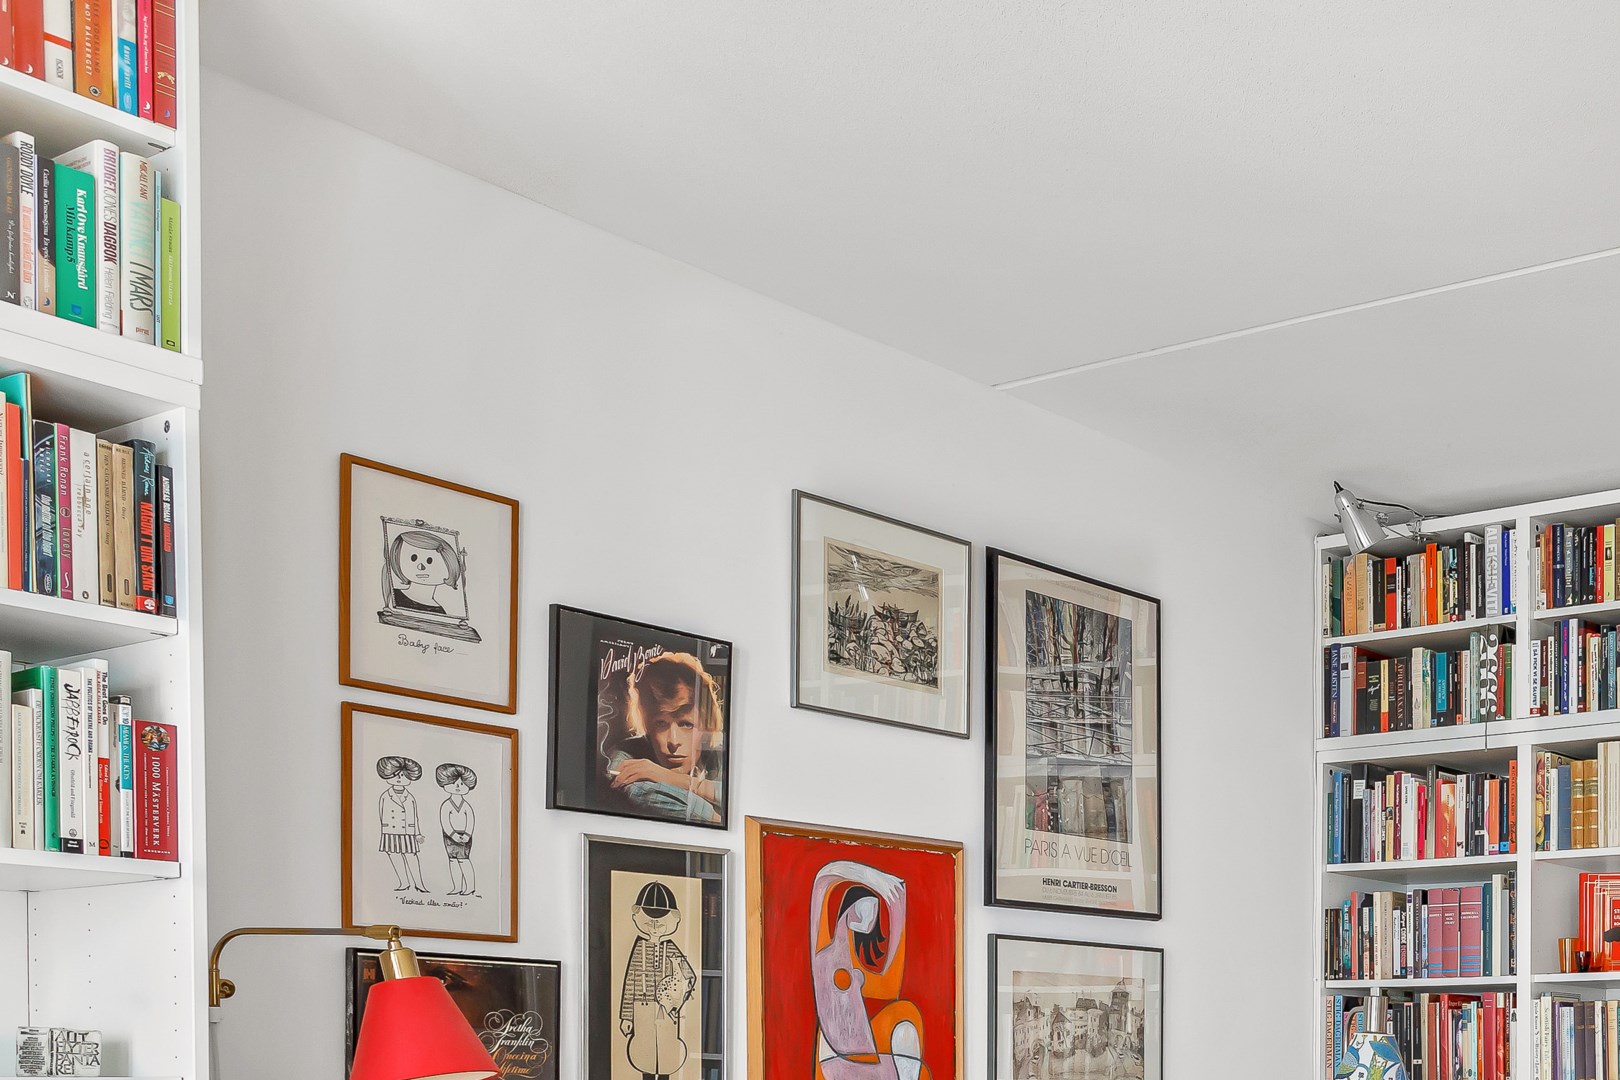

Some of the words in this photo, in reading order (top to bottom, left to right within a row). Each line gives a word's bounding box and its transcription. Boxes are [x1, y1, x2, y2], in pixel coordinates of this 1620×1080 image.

[20, 141, 34, 169] RODDY
[20, 169, 34, 197] DOYLE
[103, 148, 117, 194] BRIDGET
[76, 189, 88, 213] Karl
[65, 205, 76, 227] Min
[76, 212, 87, 234] Ove
[103, 221, 117, 266] DAGBOK
[75, 234, 89, 290] Knausgård
[103, 266, 116, 289] Helen
[102, 289, 116, 320] Fielding
[129, 270, 154, 316] MARS
[59, 434, 69, 462] Frank
[59, 466, 69, 496] Ronan
[162, 476, 171, 503] ANDREAS
[139, 502, 155, 537] NÅGON
[162, 503, 171, 523] ROMAN
[60, 526, 72, 559] lovely
[140, 545, 155, 565] DIN
[141, 564, 156, 592] SÄNG
[397, 633, 430, 654] Baby
[433, 642, 455, 654] face
[1532, 648, 1539, 658] SÅ
[600, 645, 633, 681] David
[633, 643, 664, 683] Bowie
[1331, 649, 1339, 669] JANE
[1331, 669, 1339, 699] AUSTEN
[1480, 633, 1499, 716] 2666
[101, 716, 108, 727] On
[151, 756, 161, 779] 1000
[151, 781, 161, 846] MÄSTERVERK
[1024, 837, 1058, 859] PARIS
[1060, 843, 1072, 860] A
[1074, 845, 1098, 864] VUE
[1042, 877, 1062, 887] HENRI
[1062, 879, 1118, 893] CARTIER-BRESSON
